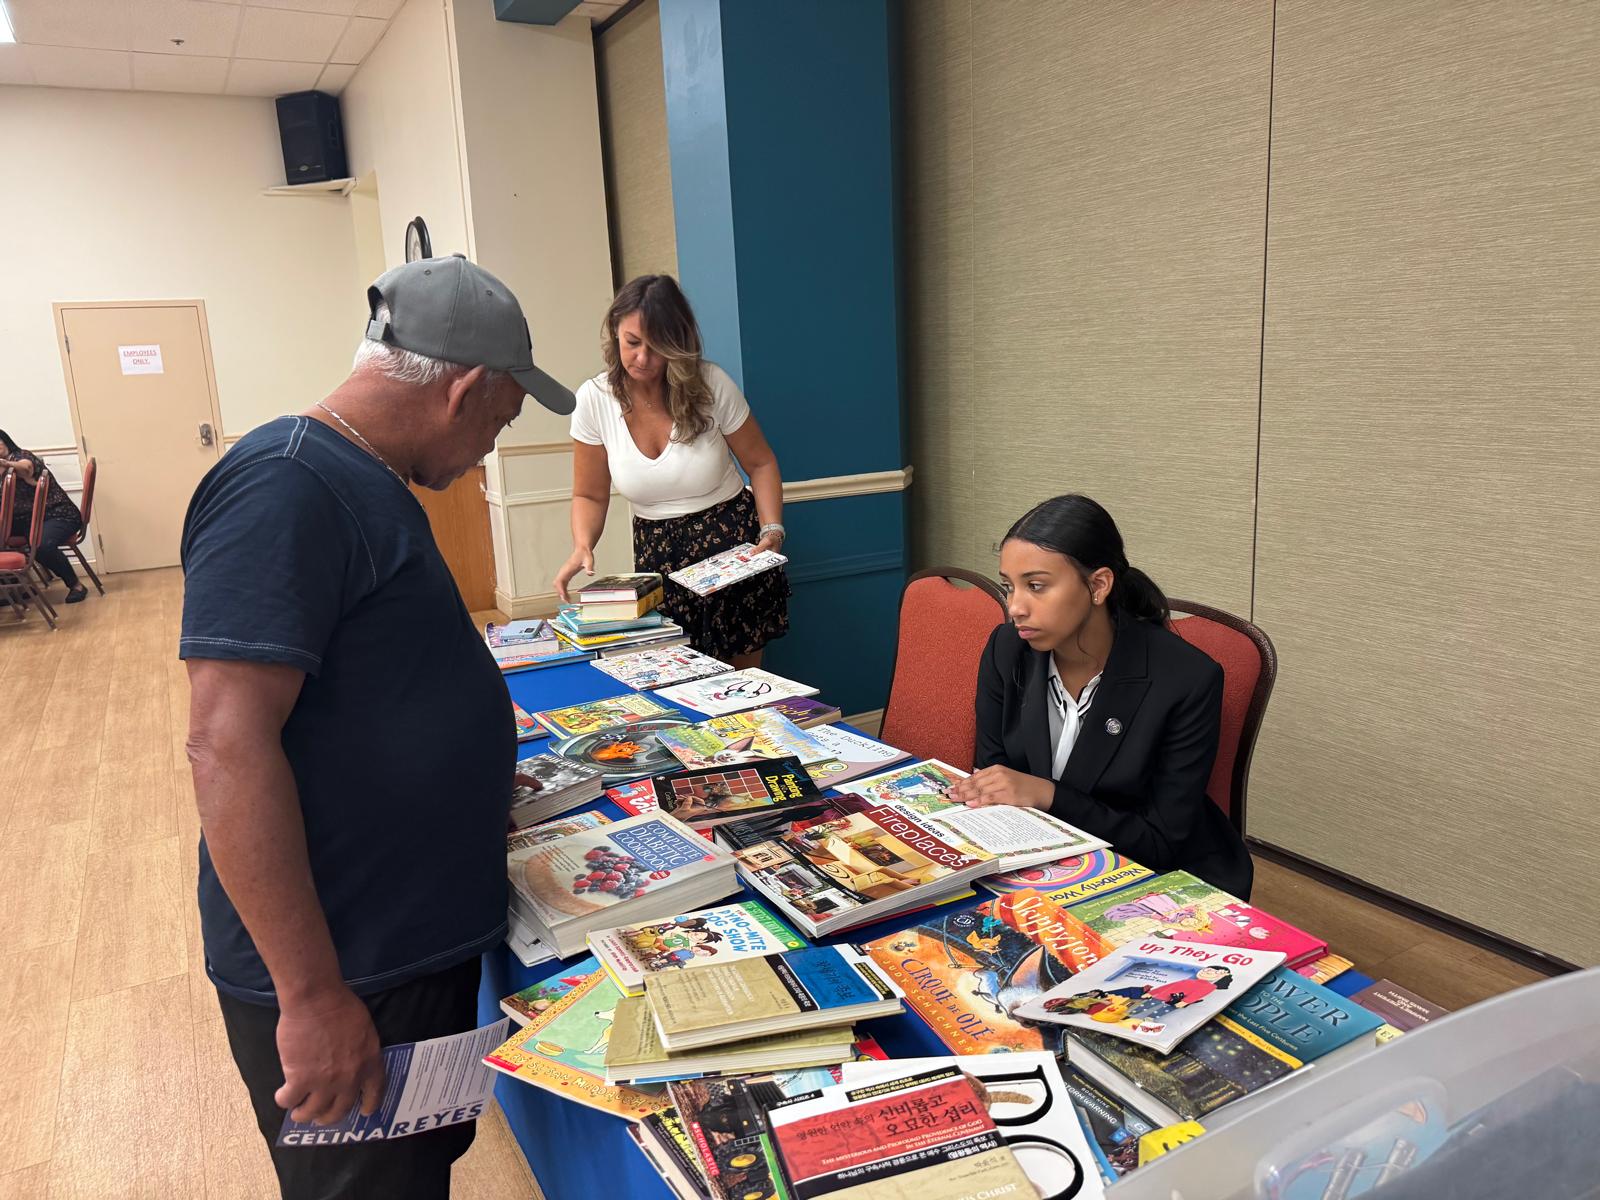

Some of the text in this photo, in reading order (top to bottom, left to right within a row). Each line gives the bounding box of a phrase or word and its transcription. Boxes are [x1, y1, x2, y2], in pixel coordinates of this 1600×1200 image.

[123, 349, 157, 357] EMPLOYEES
[840, 735, 896, 758] Duckling
[765, 775, 787, 802] Drawing
[781, 774, 803, 798] Painting
[869, 806, 970, 868] Fireplaces
[894, 804, 921, 824] design
[921, 821, 945, 838] ideas
[615, 832, 669, 870] COOKBOOK
[629, 826, 688, 865] DIABETIC
[646, 822, 703, 861] COMPLETE
[1049, 890, 1083, 902] Wor
[1080, 867, 1146, 892] Wemberly
[701, 912, 728, 927] DOG
[723, 928, 748, 952] SHOW
[718, 909, 767, 950] DYNO-MITE
[1168, 945, 1219, 962] They
[1222, 953, 1254, 967] Go
[901, 958, 957, 1005] CIRQUE
[883, 960, 973, 1053] JUDY SCHACHNER
[1260, 973, 1350, 1027] OWER
[1243, 996, 1323, 1044] OPLE
[1247, 1017, 1260, 1028] Last
[1259, 1023, 1271, 1034] Five
[1270, 1031, 1299, 1052] Centuries
[878, 1094, 948, 1122] 신비롭고
[1081, 1087, 1096, 1099] BOOK
[1084, 1097, 1118, 1124] WARNING
[282, 1127, 385, 1145] CELINA
[391, 1103, 483, 1135] REYES
[886, 1101, 978, 1137] 오묘한 섭리
[694, 1127, 720, 1175] SCHOLASTIC
[941, 1139, 973, 1152] 그리스도의
[977, 1183, 1017, 1199] CHRIST
